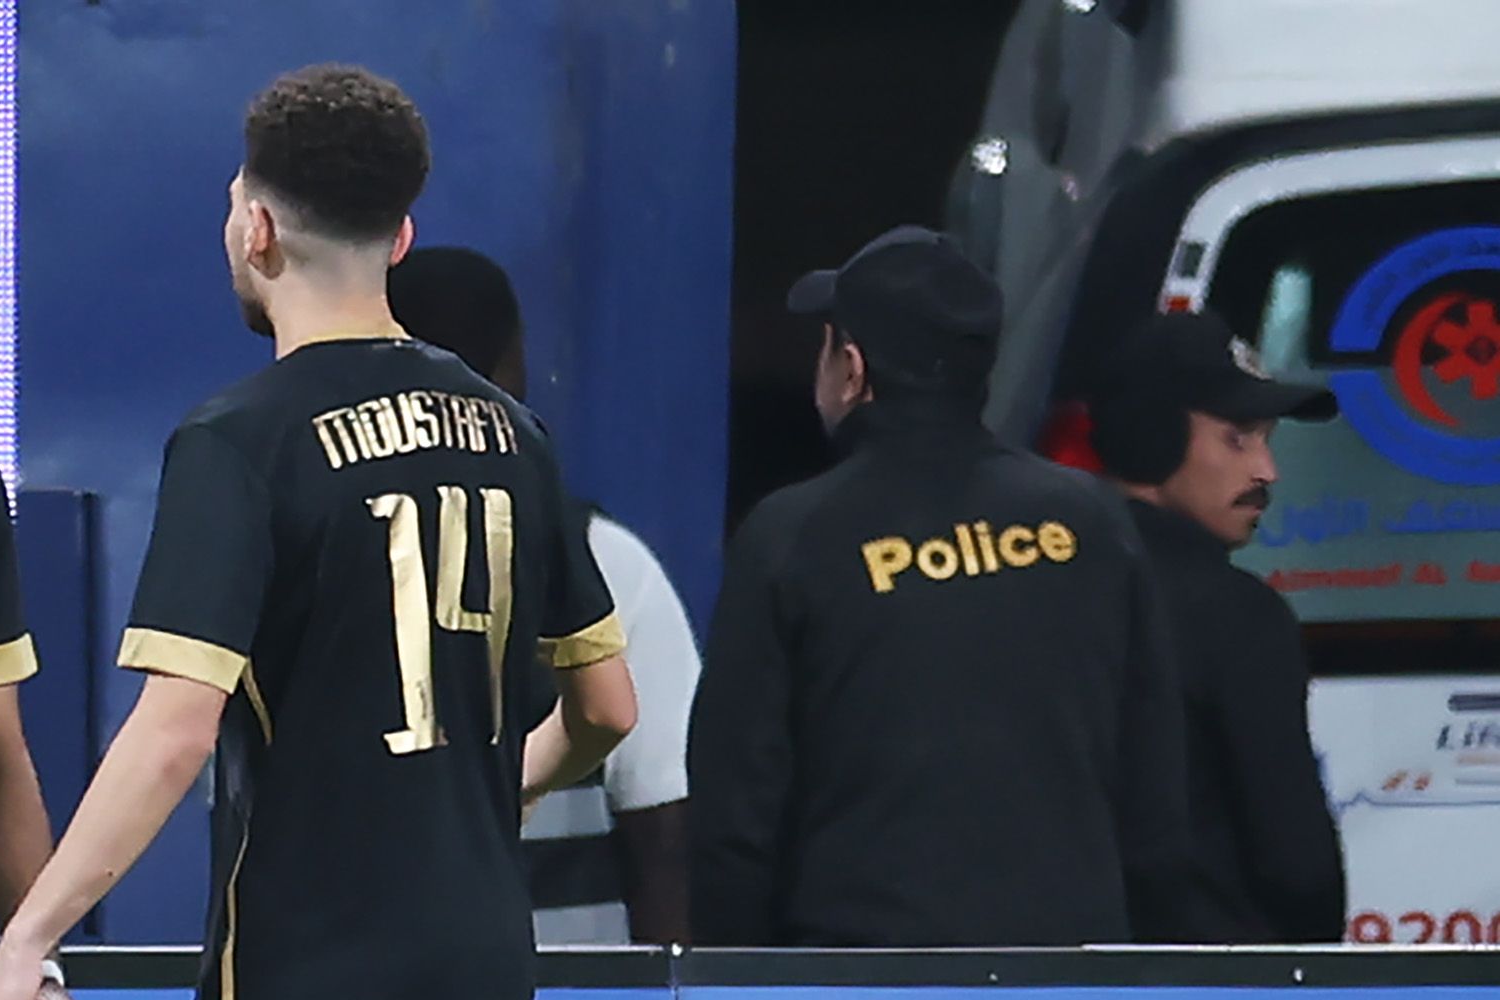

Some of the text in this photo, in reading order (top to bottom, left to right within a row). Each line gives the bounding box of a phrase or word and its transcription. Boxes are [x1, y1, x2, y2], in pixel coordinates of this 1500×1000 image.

[311, 391, 519, 469] MOUSTAFA
[860, 519, 1078, 593] Police
[364, 485, 514, 755] 14
